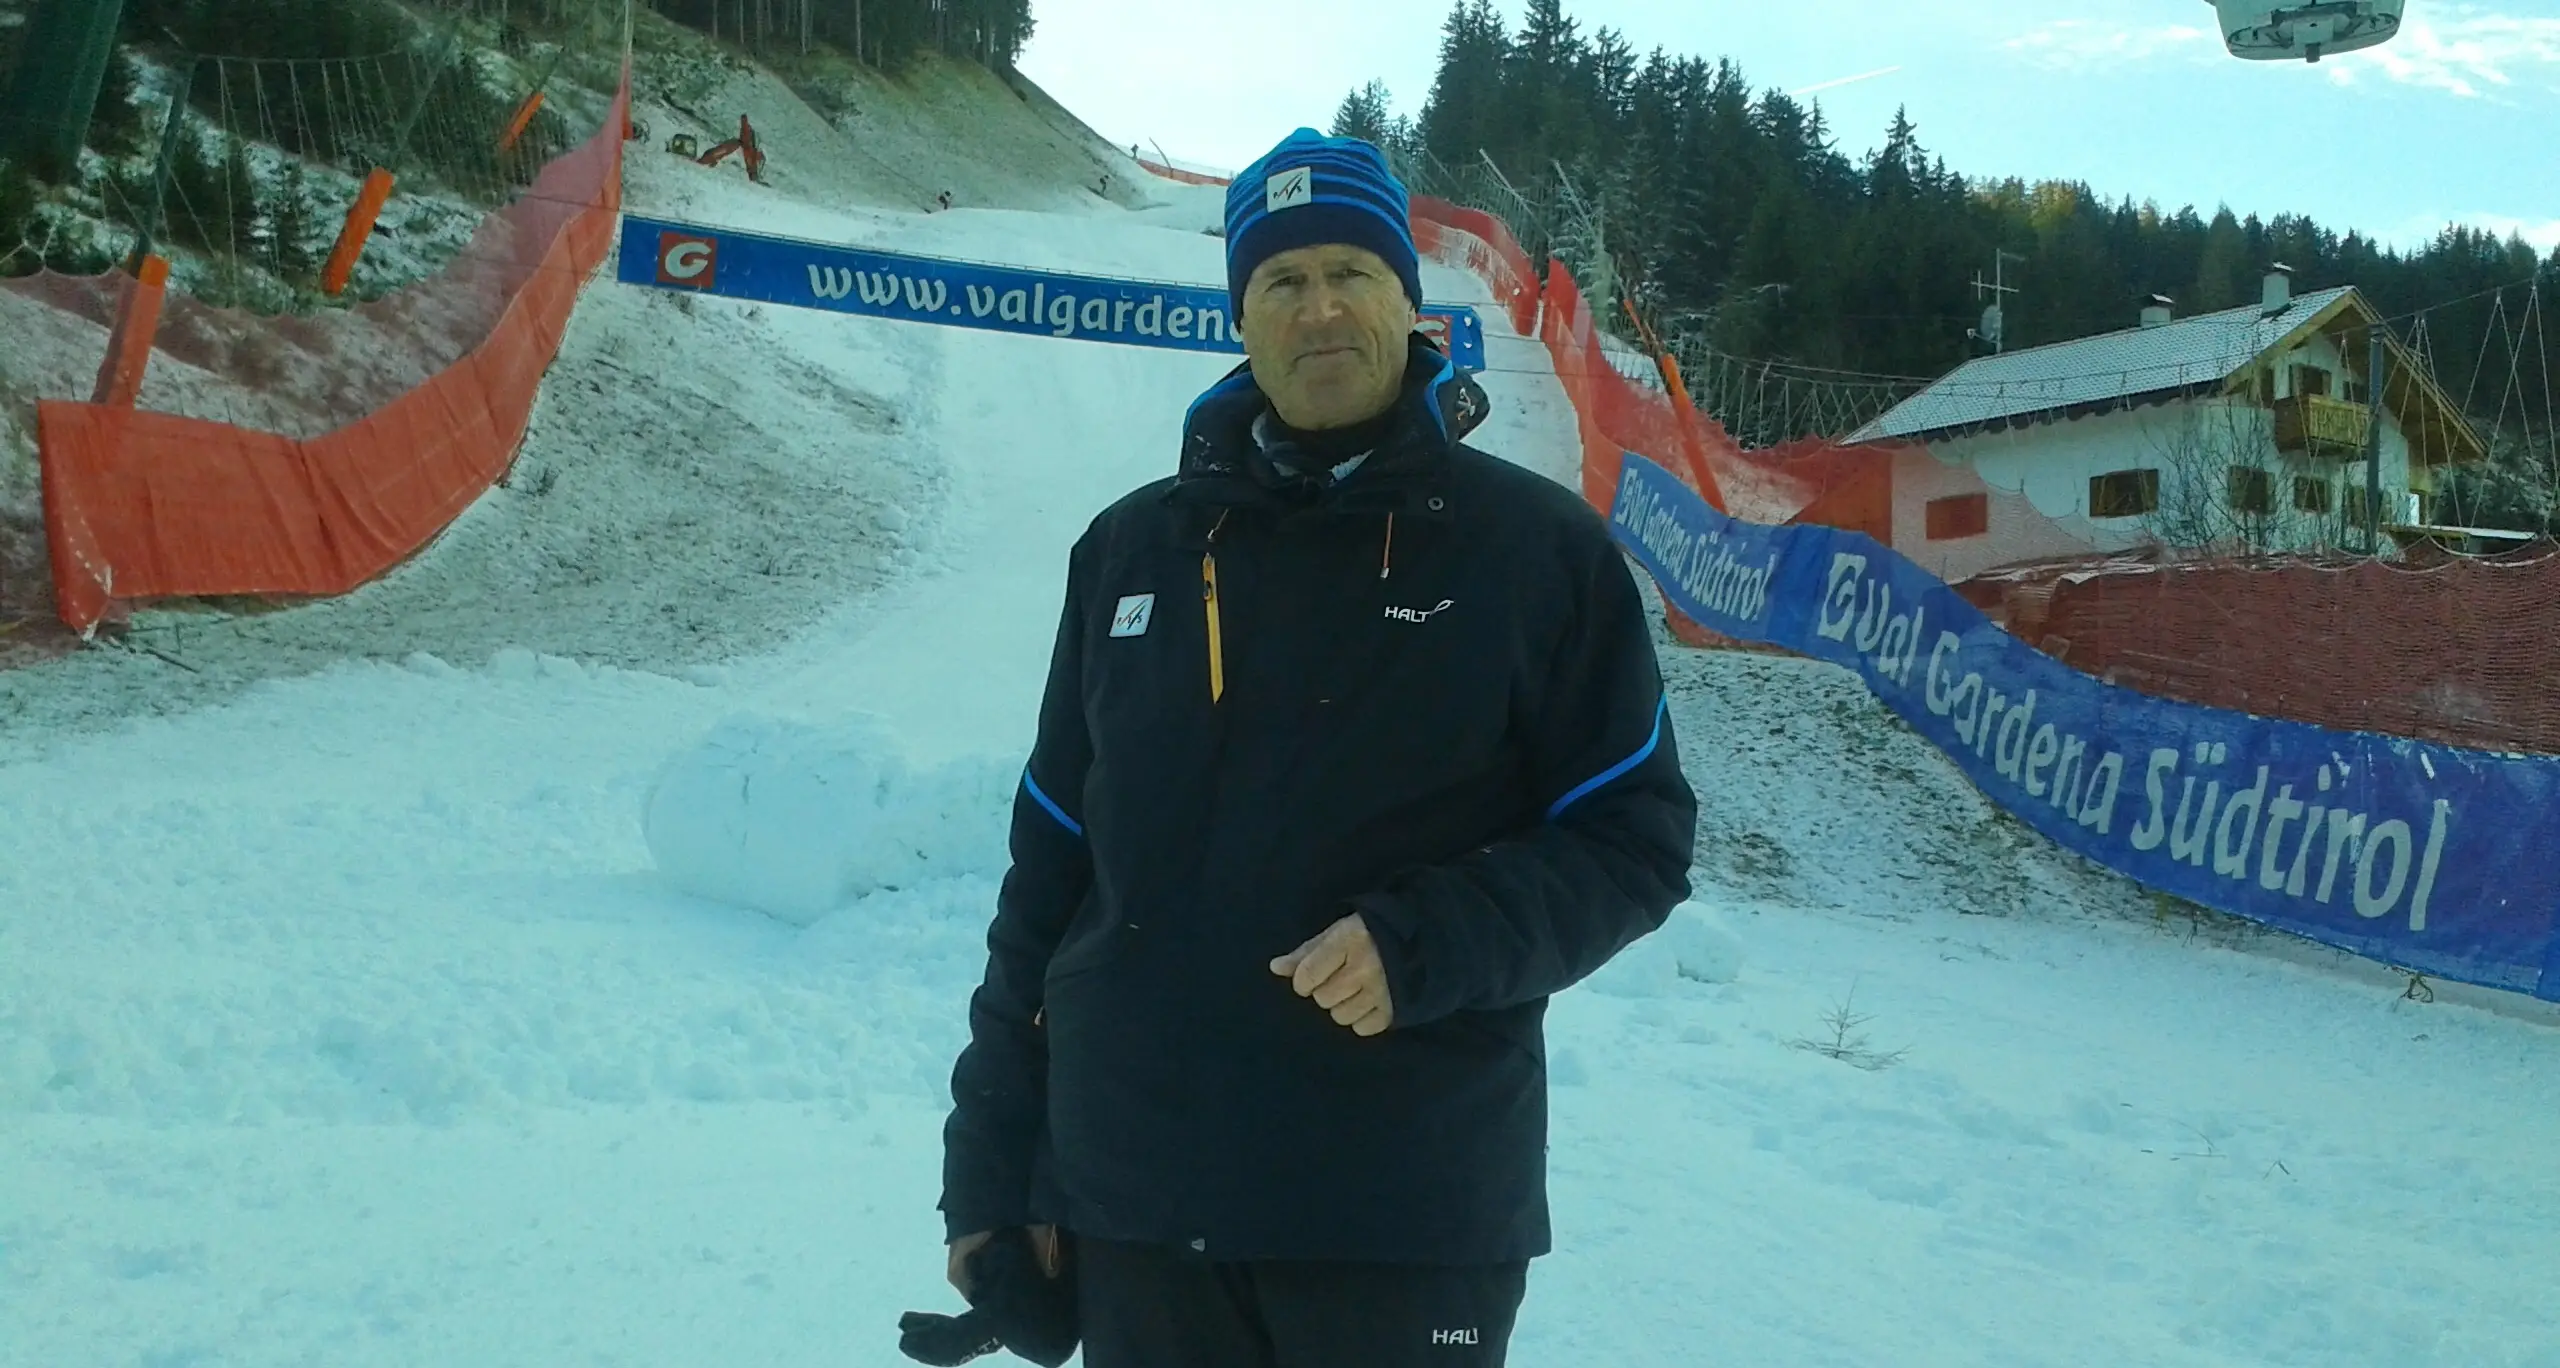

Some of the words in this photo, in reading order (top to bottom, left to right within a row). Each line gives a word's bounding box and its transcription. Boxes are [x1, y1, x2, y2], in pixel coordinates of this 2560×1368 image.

[1682, 531, 1776, 621] Südtirol
[1855, 579, 1924, 687] Val
[1925, 630, 2123, 834] Gardena
[2130, 741, 2449, 931] Südtirol
